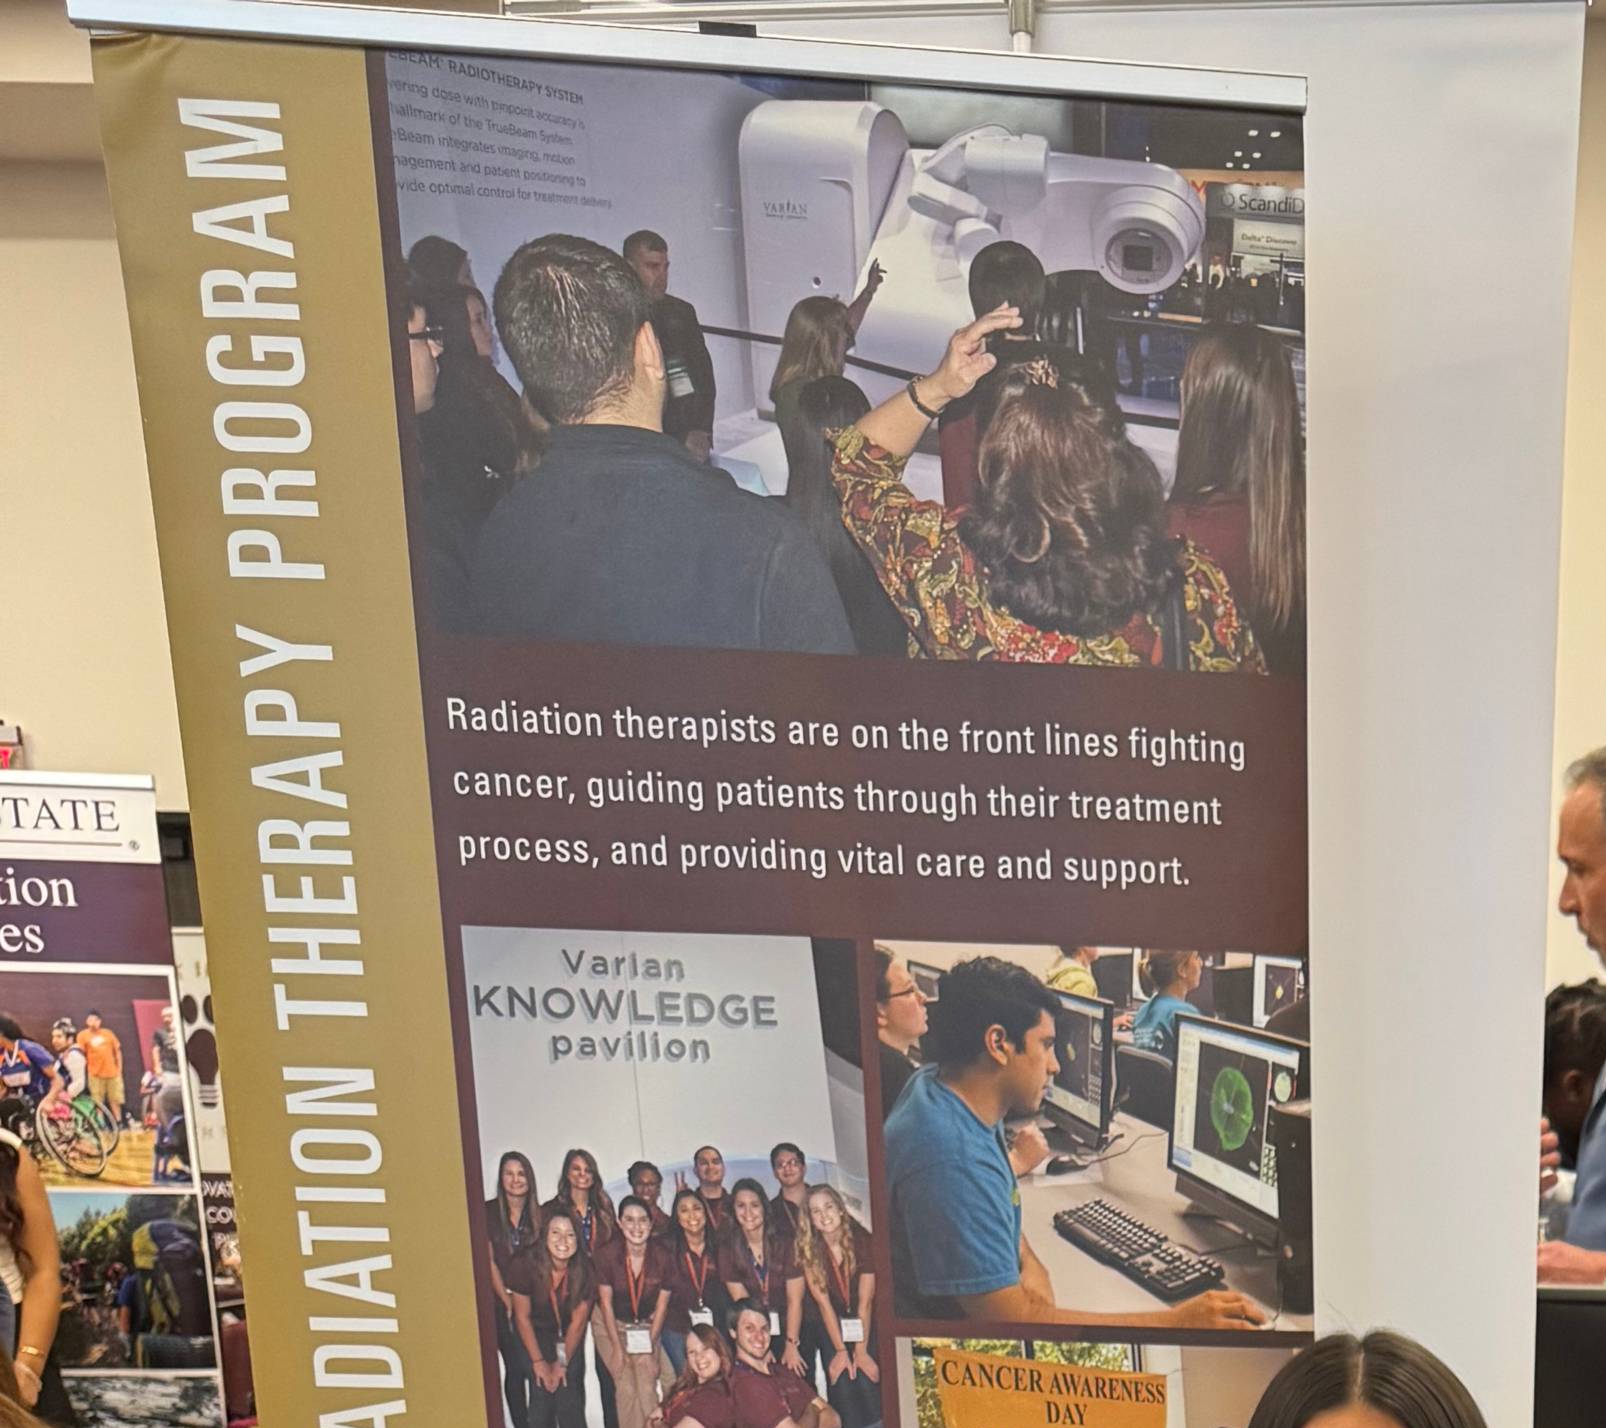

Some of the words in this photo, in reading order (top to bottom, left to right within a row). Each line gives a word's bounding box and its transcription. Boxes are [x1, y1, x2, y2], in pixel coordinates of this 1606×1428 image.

[448, 60, 542, 94] RADIOTHERAPY
[545, 86, 583, 104] SYSTEM
[177, 97, 326, 580] PROGRAM
[446, 697, 602, 737] Radiation
[612, 705, 776, 749] therapists
[788, 721, 839, 747] are
[851, 724, 889, 749] on
[898, 718, 949, 752] the
[959, 720, 1036, 754] front
[1045, 722, 1119, 758] lines
[1128, 726, 1245, 772] fighting
[0, 798, 120, 832] TATE
[453, 771, 575, 805] cancer,
[587, 770, 704, 812] guiding
[716, 775, 845, 813] patients
[853, 780, 977, 822] through
[986, 784, 1060, 818] their
[1068, 791, 1222, 826] treatment
[235, 623, 369, 1031] THERAPY
[458, 835, 599, 869] process,
[611, 834, 668, 866] and
[680, 837, 827, 879] providing
[837, 842, 904, 875] vital
[916, 853, 985, 878] care
[997, 848, 1052, 880] and
[1063, 857, 1190, 890] support.
[560, 948, 686, 983] Varian
[472, 983, 779, 1029] KNOWLEDGE
[549, 1031, 712, 1064] pavilion
[941, 1359, 1044, 1394] CANCER
[1050, 1372, 1166, 1404] AWARENESS
[1045, 1400, 1088, 1426] DAY
